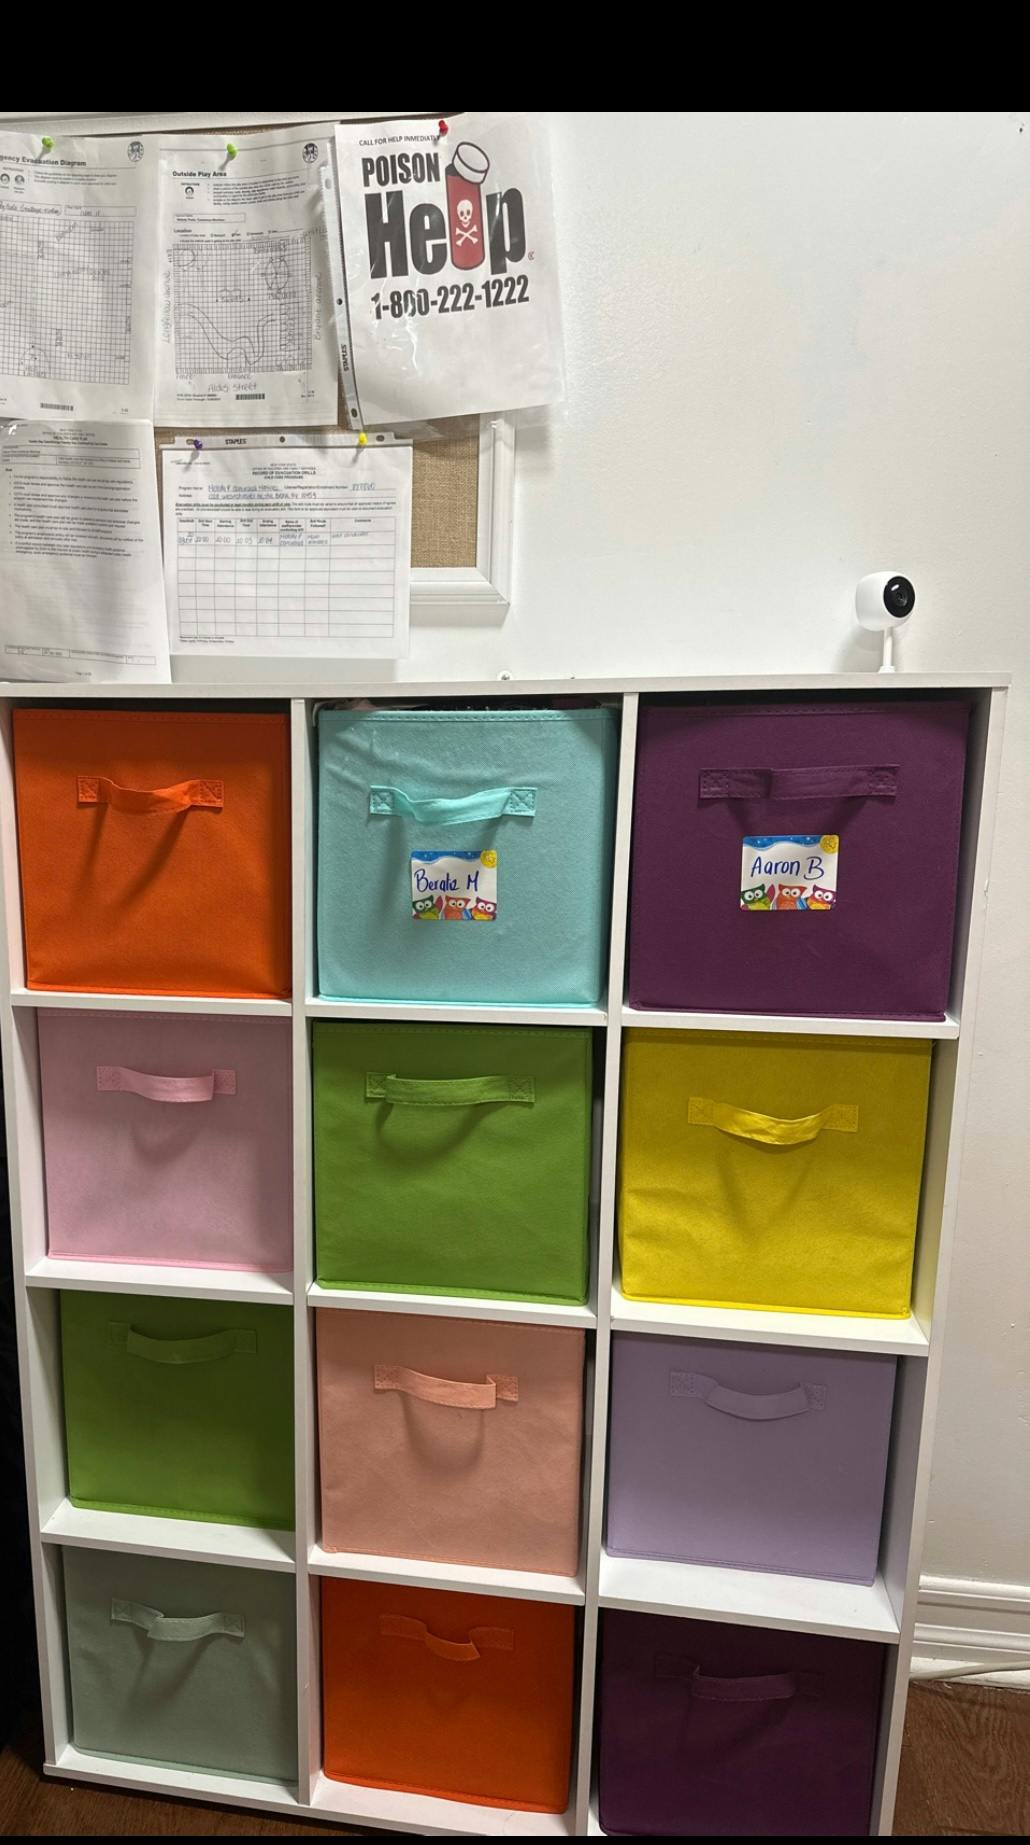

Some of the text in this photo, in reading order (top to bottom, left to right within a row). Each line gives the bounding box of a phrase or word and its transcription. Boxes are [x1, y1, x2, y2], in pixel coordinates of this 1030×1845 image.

[388, 135, 403, 143] HELP
[60, 159, 87, 167] Diagram
[172, 170, 197, 178] Outside
[361, 152, 441, 187] POISON
[364, 187, 527, 280] Help
[370, 274, 530, 320] 1-800-222-1222
[750, 855, 825, 880] Aaron B
[466, 870, 480, 892] M
